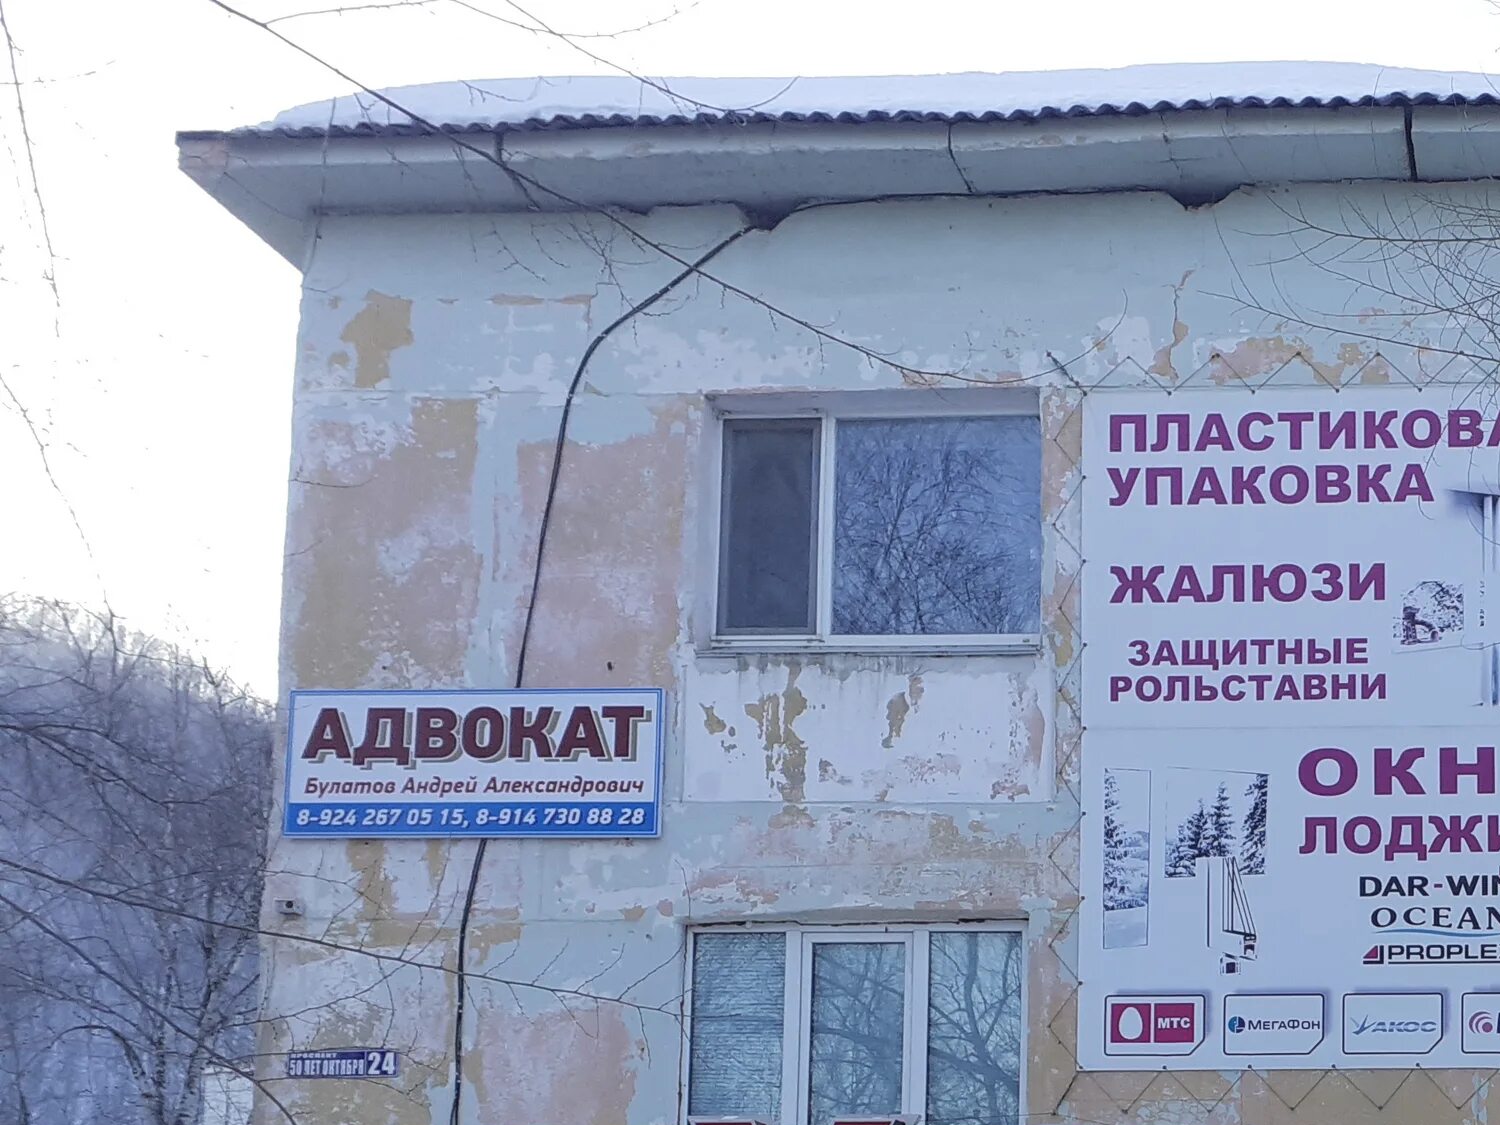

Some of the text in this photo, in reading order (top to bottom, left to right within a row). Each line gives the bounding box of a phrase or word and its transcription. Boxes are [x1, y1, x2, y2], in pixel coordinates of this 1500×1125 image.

[1106, 463, 1435, 507] УПАКОВКА
[1109, 562, 1386, 604] ЖАЛЮЗИ
[1128, 638, 1369, 671] ЗАЩИТНЫЕ
[1109, 673, 1387, 703] РОЛЬСТАВНИ
[301, 705, 651, 768] АДВОКАТ
[304, 775, 645, 798] Булатов Андрей Александрович
[296, 808, 645, 829] 8-924 267 05 15, 8-914 730 88 28
[1157, 1016, 1191, 1031] МТС
[290, 1060, 303, 1076] 50
[322, 1059, 364, 1076] ОКТЯБРЯ
[367, 1052, 395, 1075] 24
